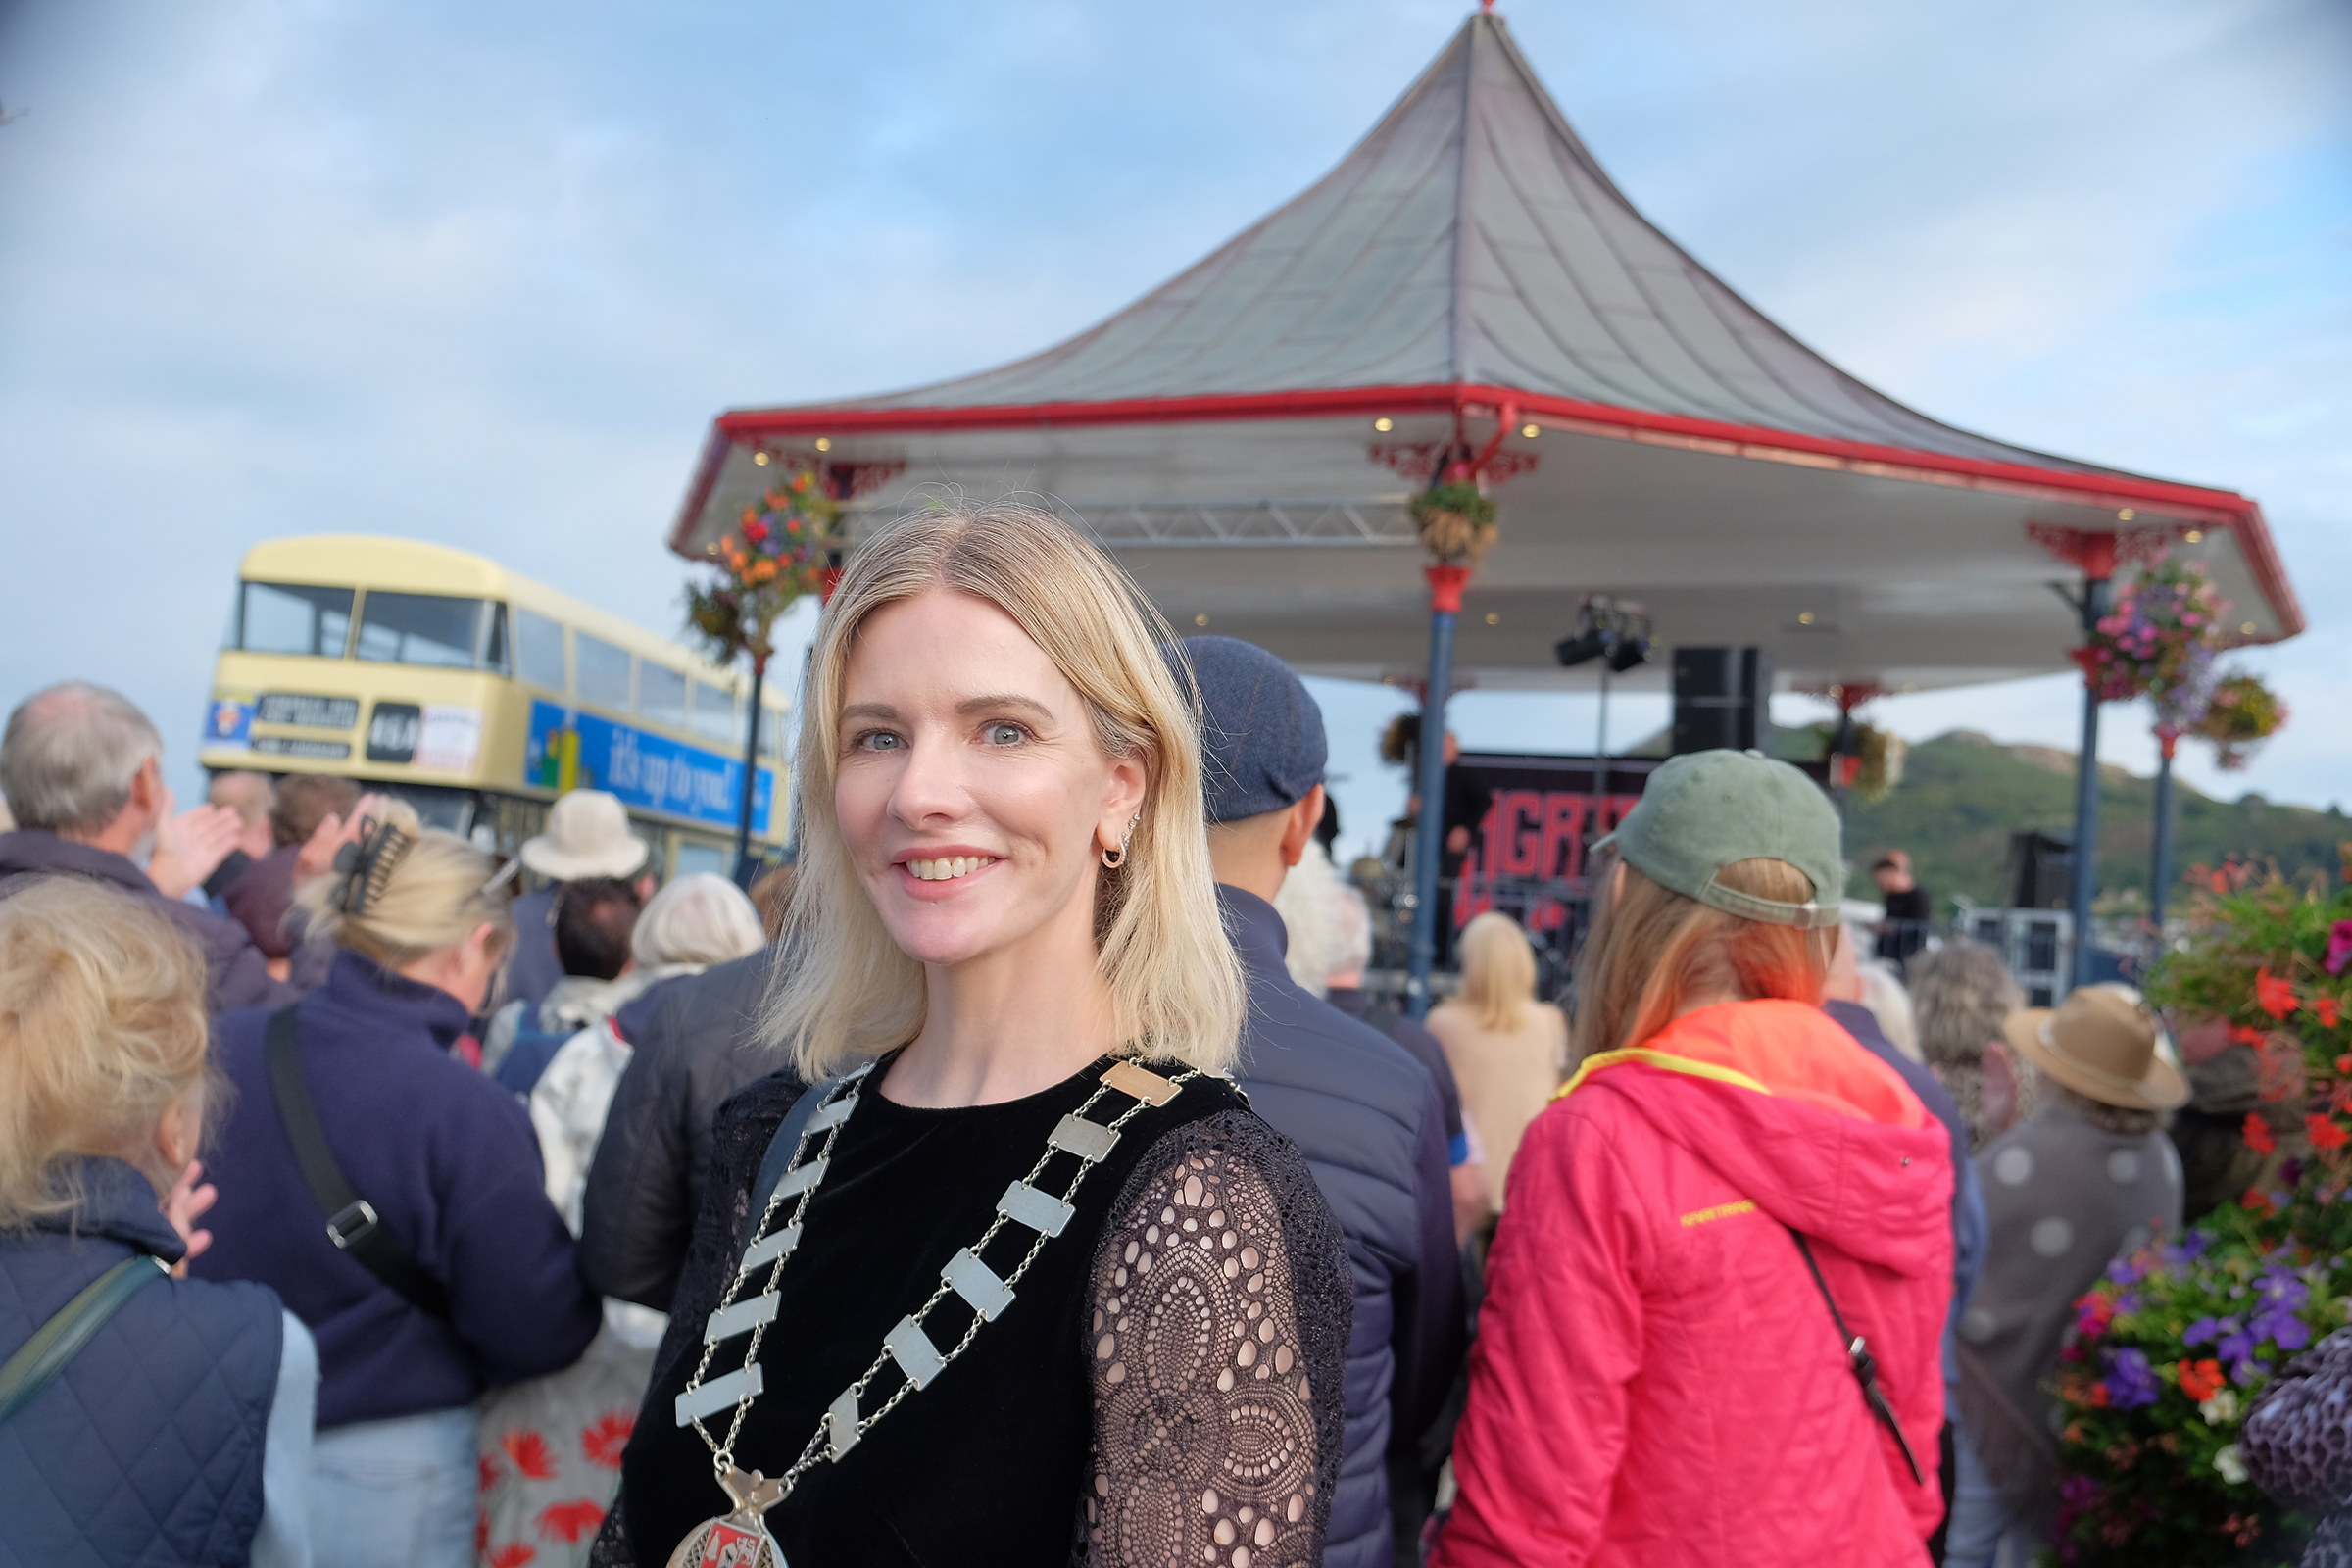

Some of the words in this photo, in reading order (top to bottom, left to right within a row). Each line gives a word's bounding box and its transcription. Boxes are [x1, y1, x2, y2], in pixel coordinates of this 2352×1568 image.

[642, 753, 669, 810] up
[670, 750, 692, 802] to
[690, 761, 734, 816] you!
